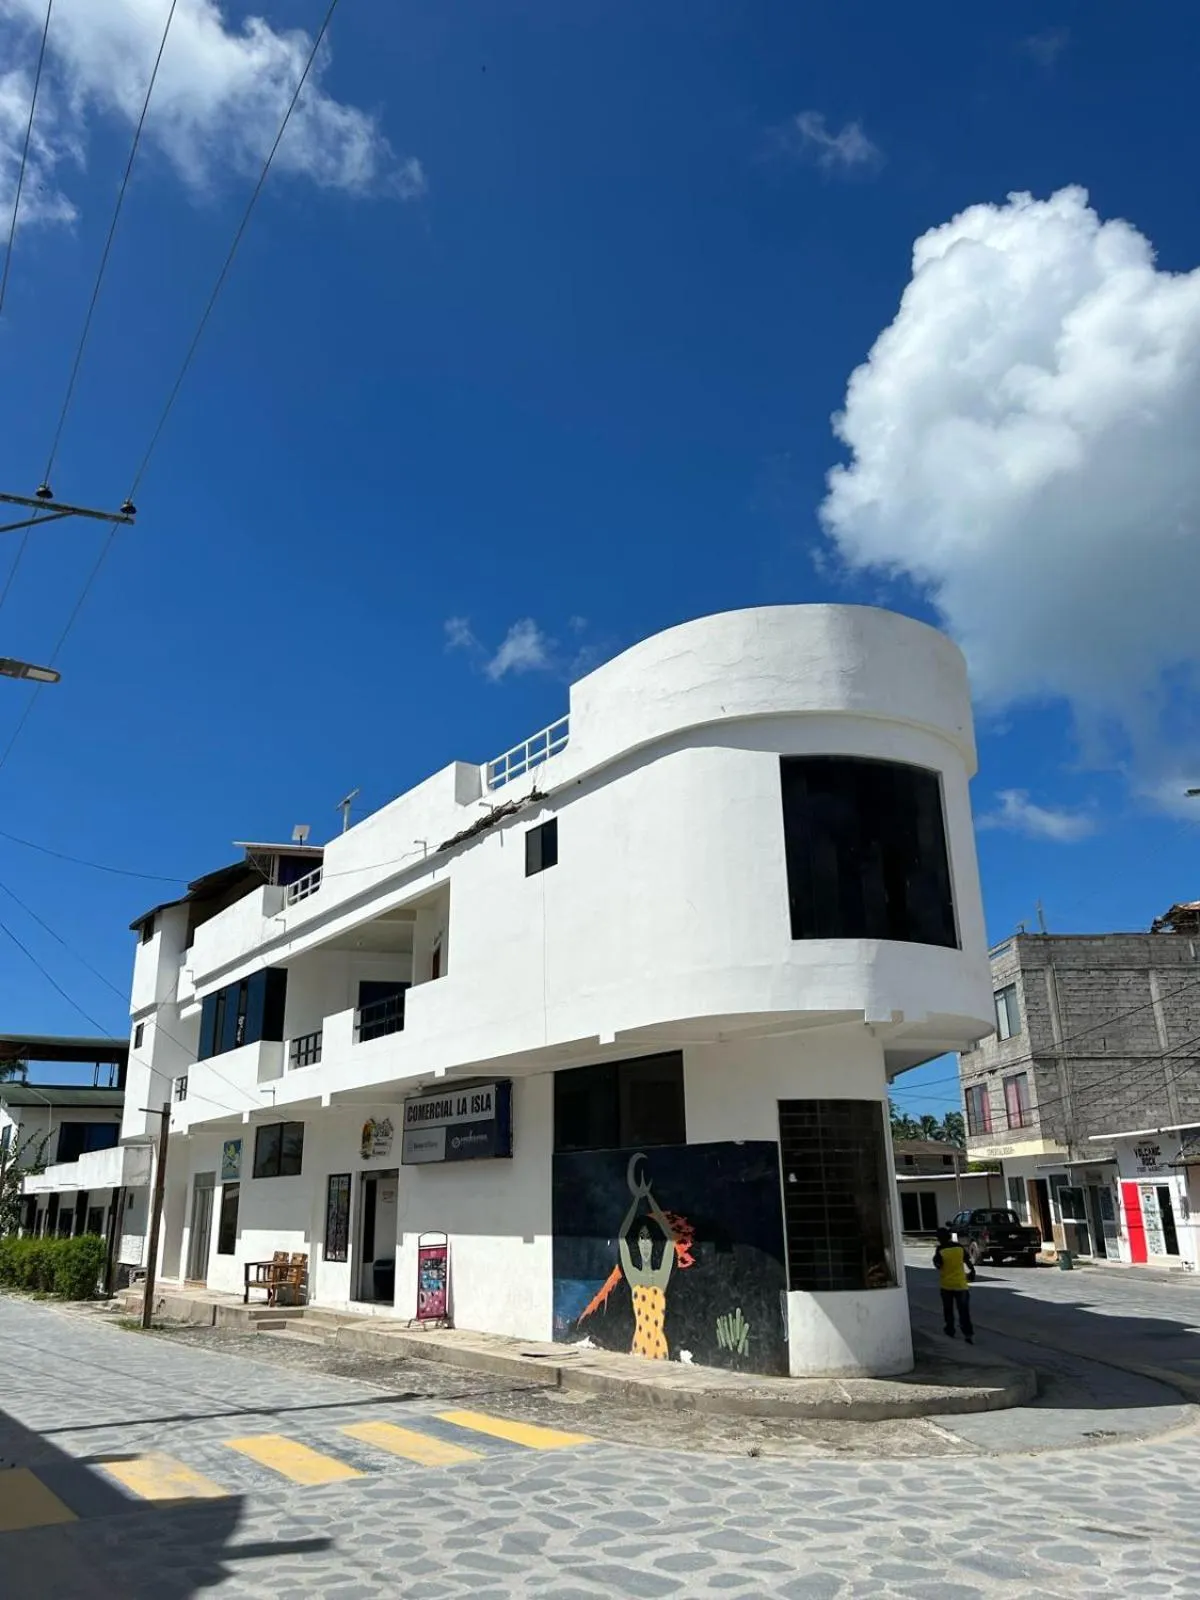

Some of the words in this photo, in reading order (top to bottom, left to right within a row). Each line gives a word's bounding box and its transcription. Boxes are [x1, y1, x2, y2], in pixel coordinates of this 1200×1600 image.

[407, 1099, 453, 1122] COMERCIAL
[456, 1096, 467, 1116] LA
[471, 1093, 491, 1113] ISLA
